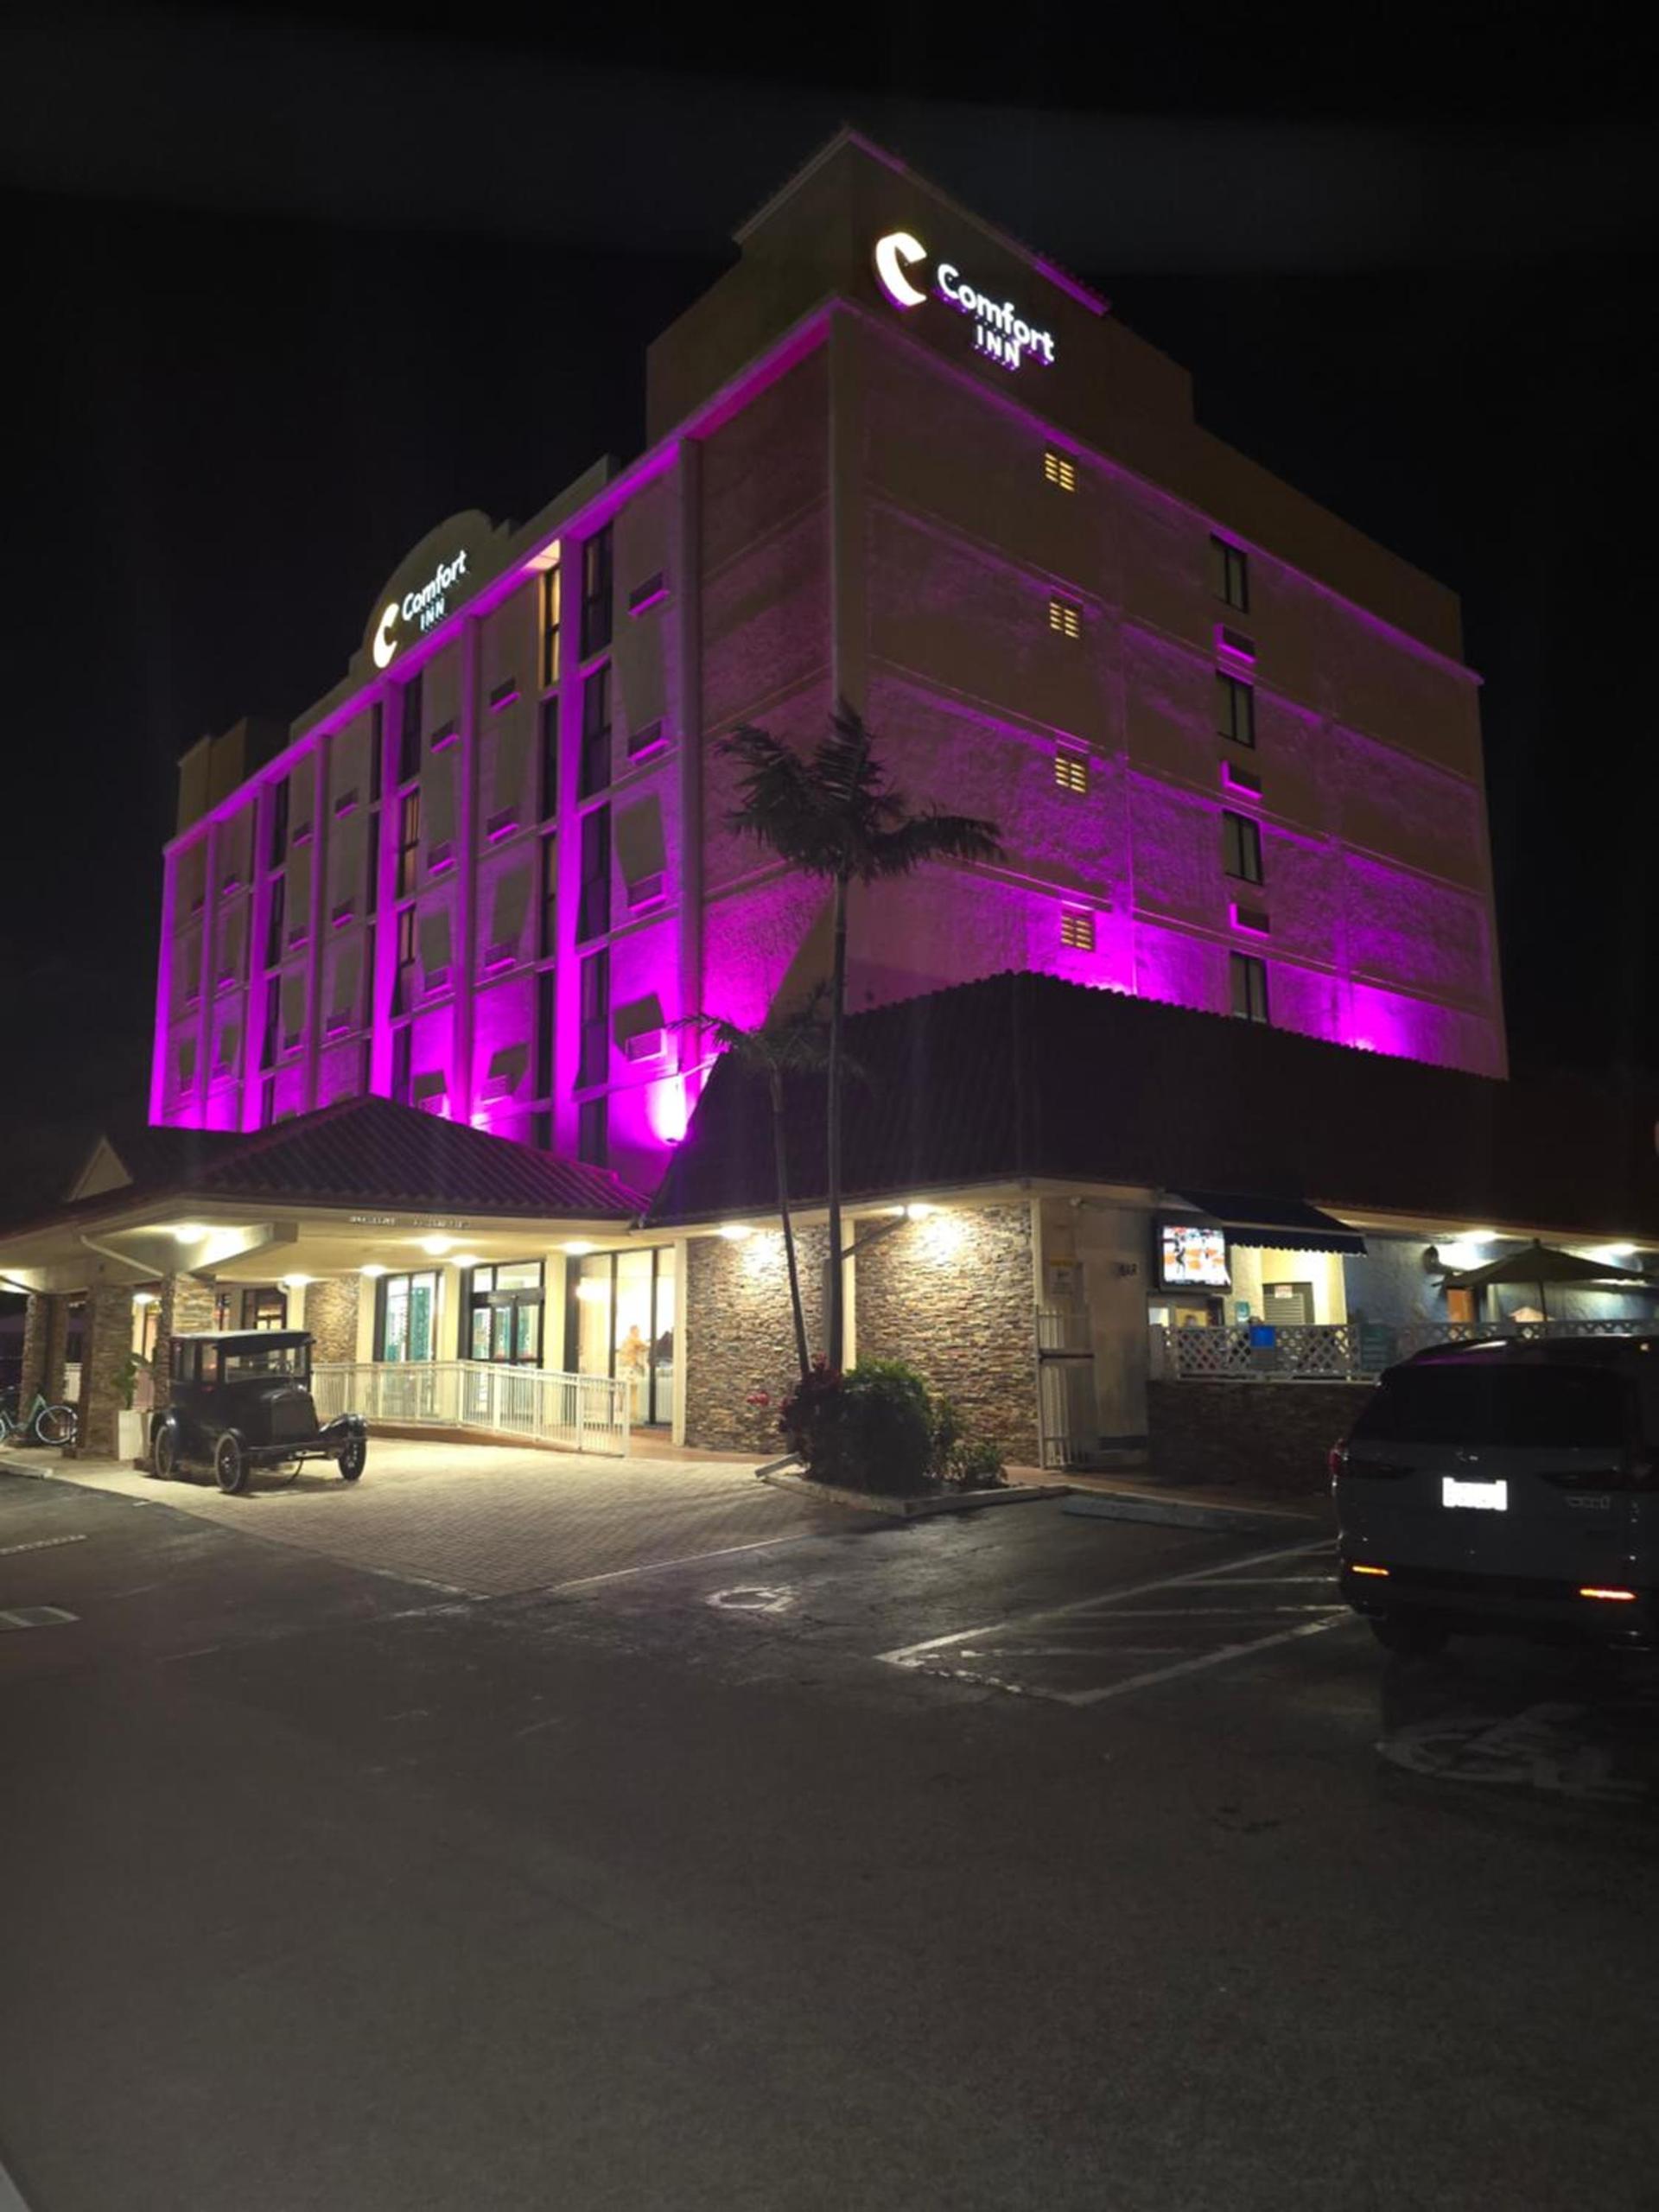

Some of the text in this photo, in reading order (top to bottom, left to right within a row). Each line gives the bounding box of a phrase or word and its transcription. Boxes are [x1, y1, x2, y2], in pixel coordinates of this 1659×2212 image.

[938, 263, 1055, 362] Comfort
[976, 324, 1020, 367] INN
[402, 550, 467, 621] Comfort
[420, 597, 445, 632] INN
